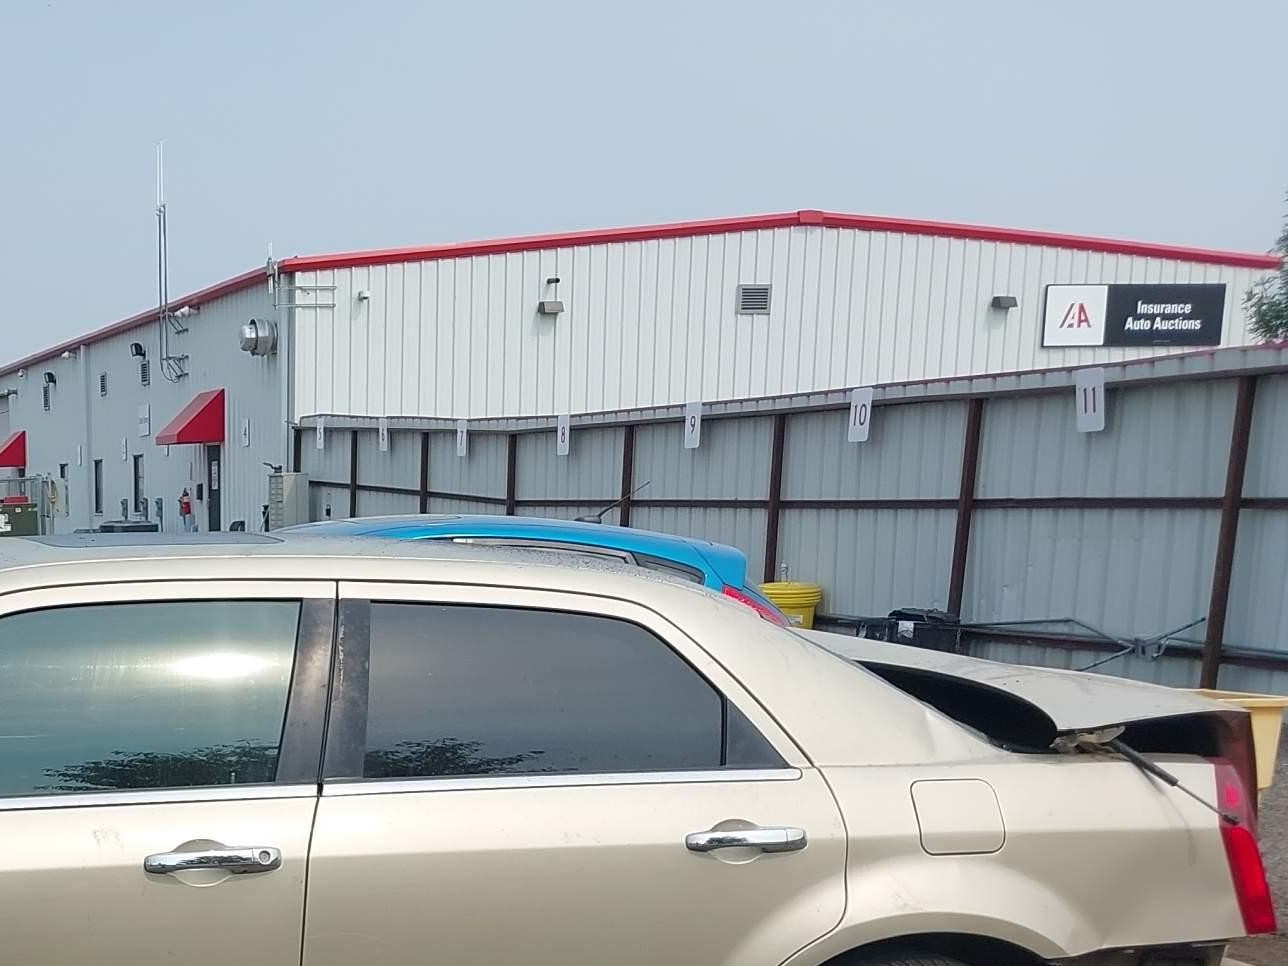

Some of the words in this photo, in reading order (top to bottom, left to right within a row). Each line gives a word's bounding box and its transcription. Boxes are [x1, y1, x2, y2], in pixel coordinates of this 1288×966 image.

[1136, 300, 1192, 314] Insurance
[1124, 316, 1151, 330] Auto
[1152, 316, 1202, 330] Auctions
[1082, 386, 1097, 414] 11
[853, 403, 868, 427] 10
[689, 416, 697, 433] 9
[560, 427, 566, 444] 8
